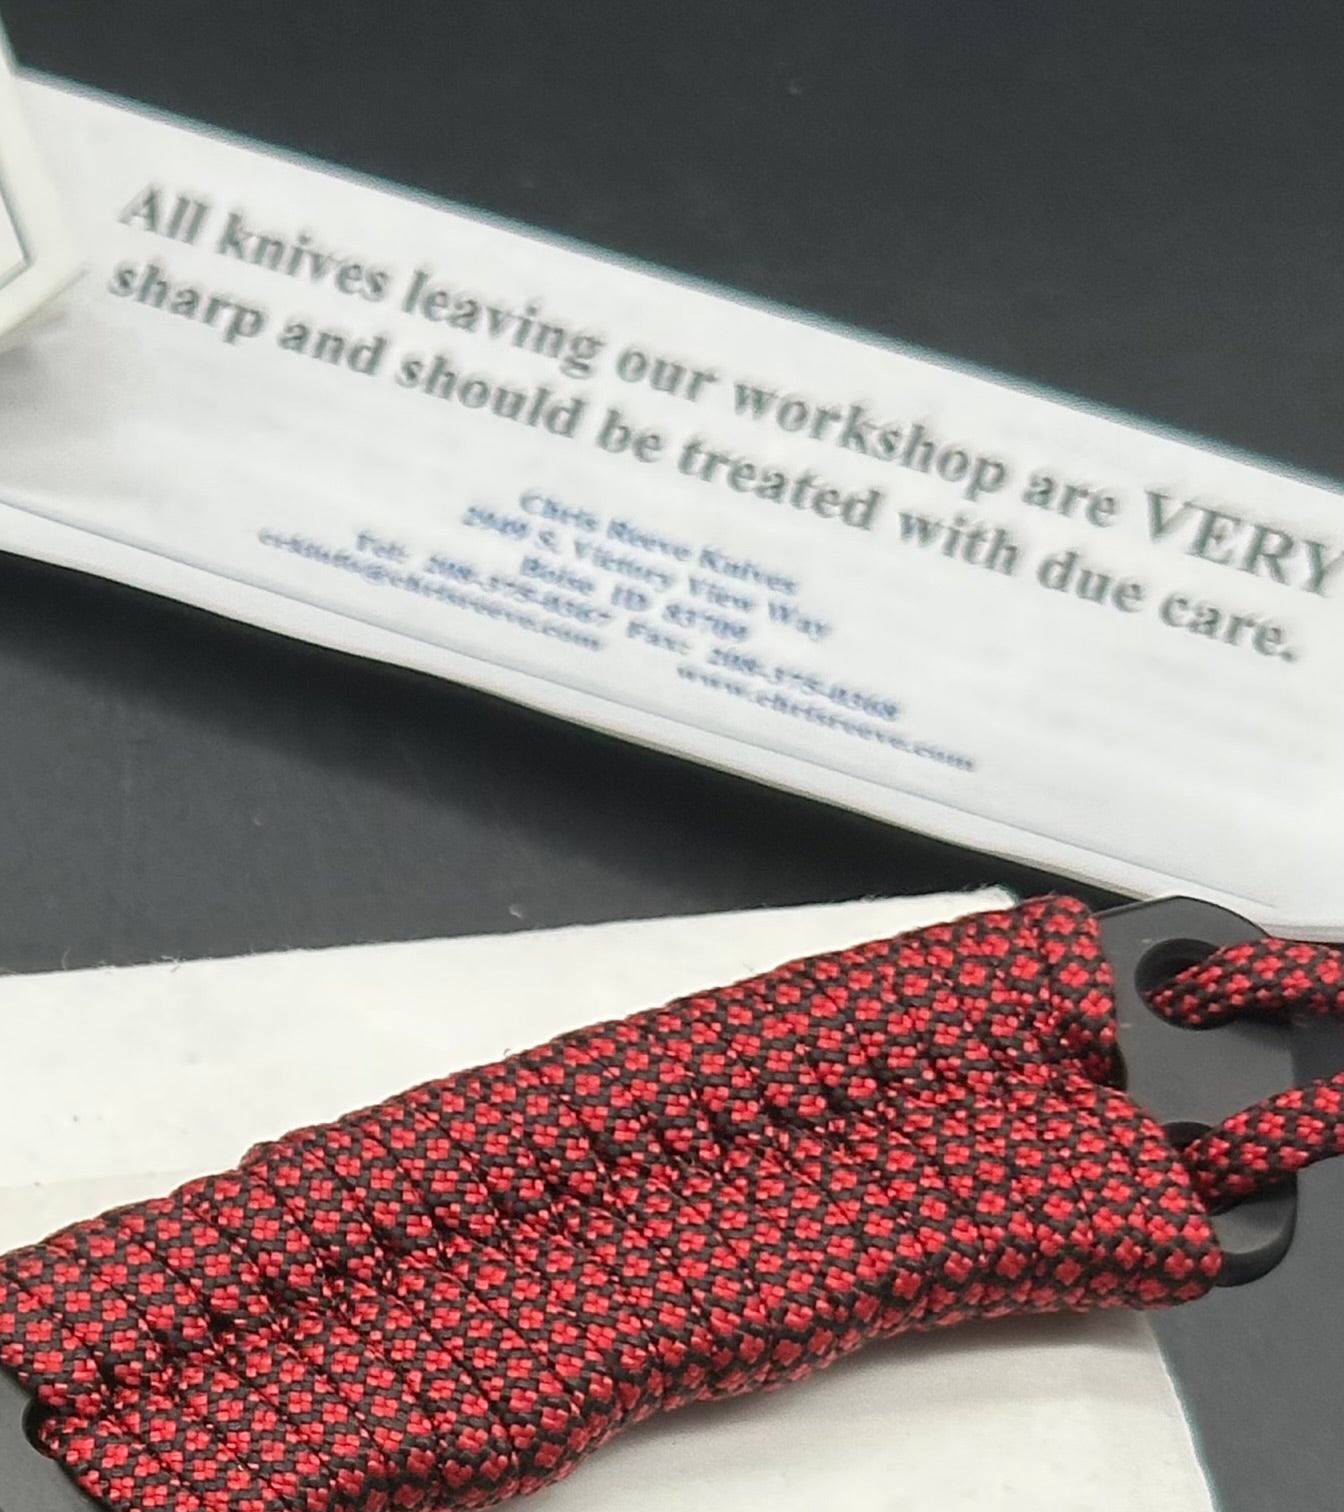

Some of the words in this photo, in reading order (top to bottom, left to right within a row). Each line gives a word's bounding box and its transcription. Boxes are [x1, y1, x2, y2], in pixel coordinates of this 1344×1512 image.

[109, 259, 265, 345] sharp
[277, 316, 389, 377] and
[396, 354, 586, 440] should
[594, 409, 664, 463] be
[678, 433, 885, 533] treated
[898, 507, 1020, 577] with
[1037, 549, 1146, 613] due
[1159, 589, 1298, 663] care.
[119, 181, 209, 246] All
[217, 213, 390, 304] knives
[401, 268, 605, 380] leaving
[616, 345, 718, 405] our
[733, 379, 1008, 502] workshop
[1021, 468, 1119, 527] are
[1146, 489, 1344, 598] VERY
